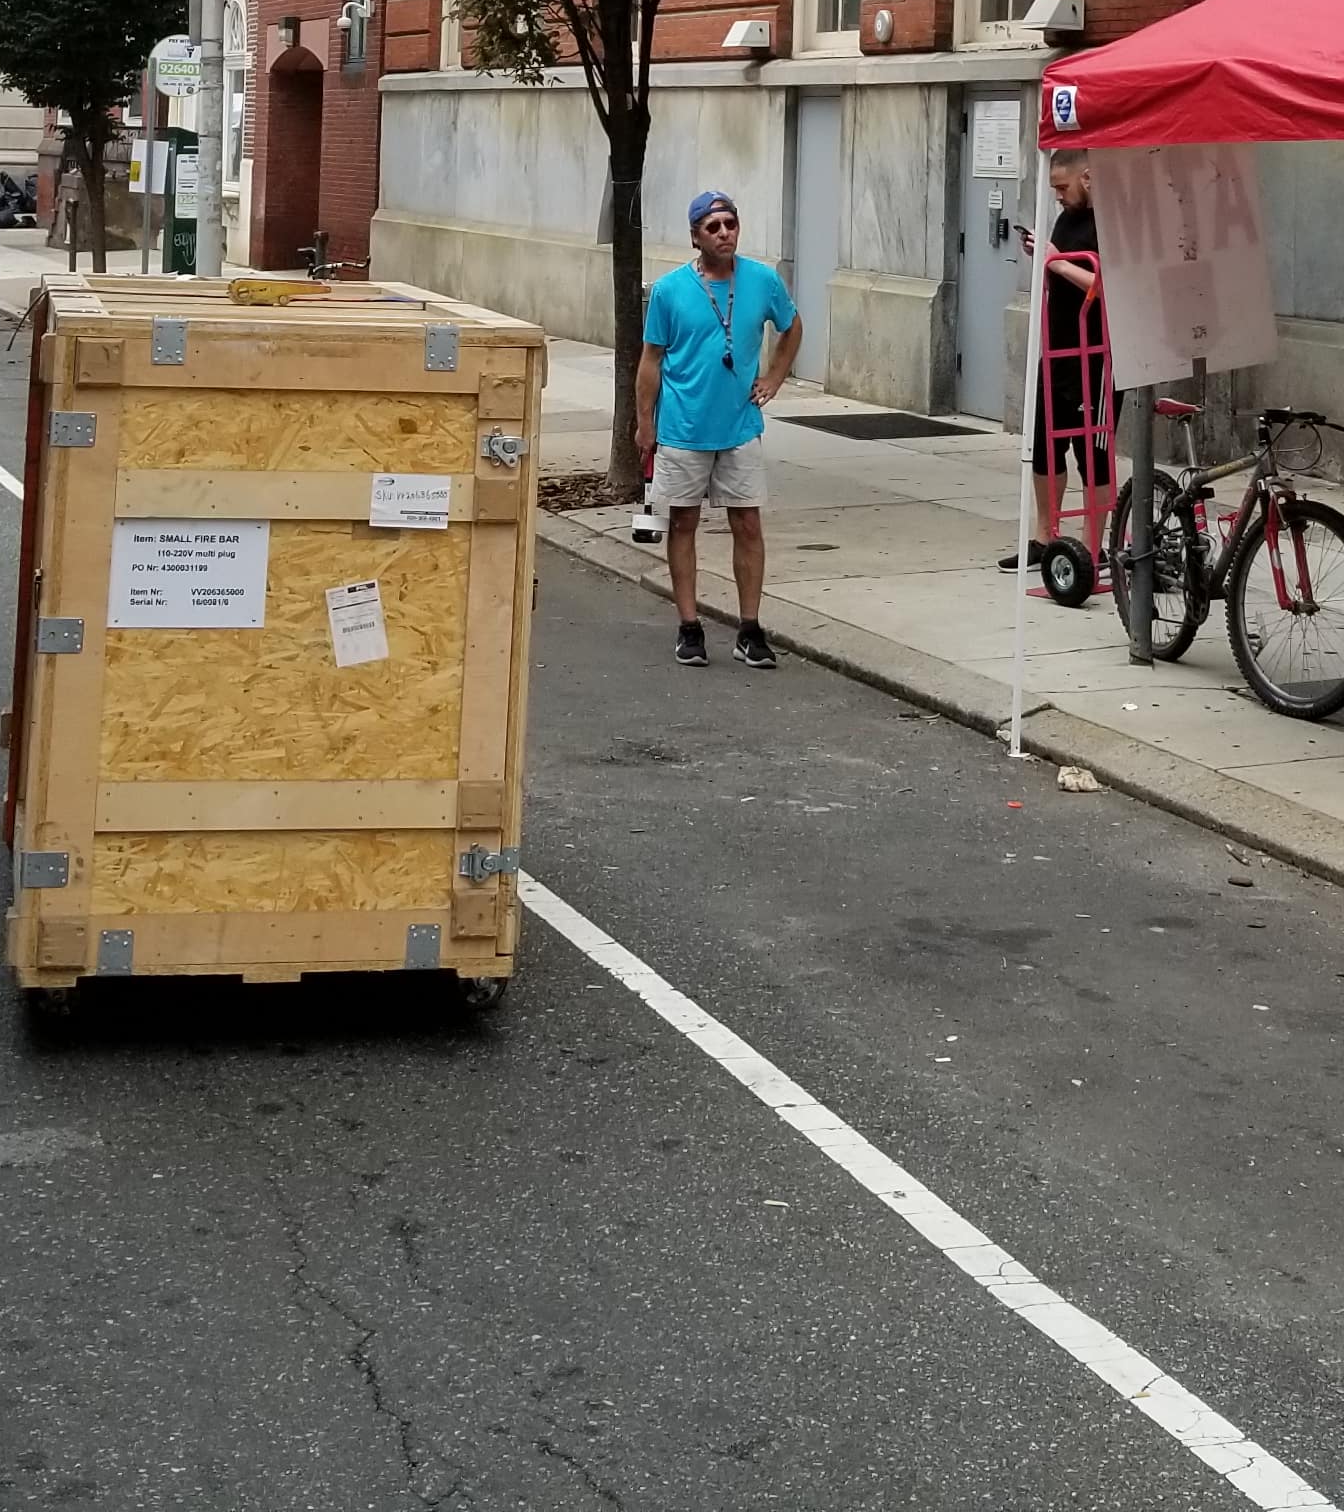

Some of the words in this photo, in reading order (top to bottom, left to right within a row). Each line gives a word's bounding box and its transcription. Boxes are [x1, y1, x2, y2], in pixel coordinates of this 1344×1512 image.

[159, 63, 200, 74] 926401
[133, 534, 157, 543] Item:
[159, 534, 192, 543] SMALL
[194, 535, 216, 543] FIRE
[218, 535, 240, 543] BAR
[217, 550, 236, 559] plug
[130, 598, 153, 606] Serial
[155, 598, 168, 606] Nr:
